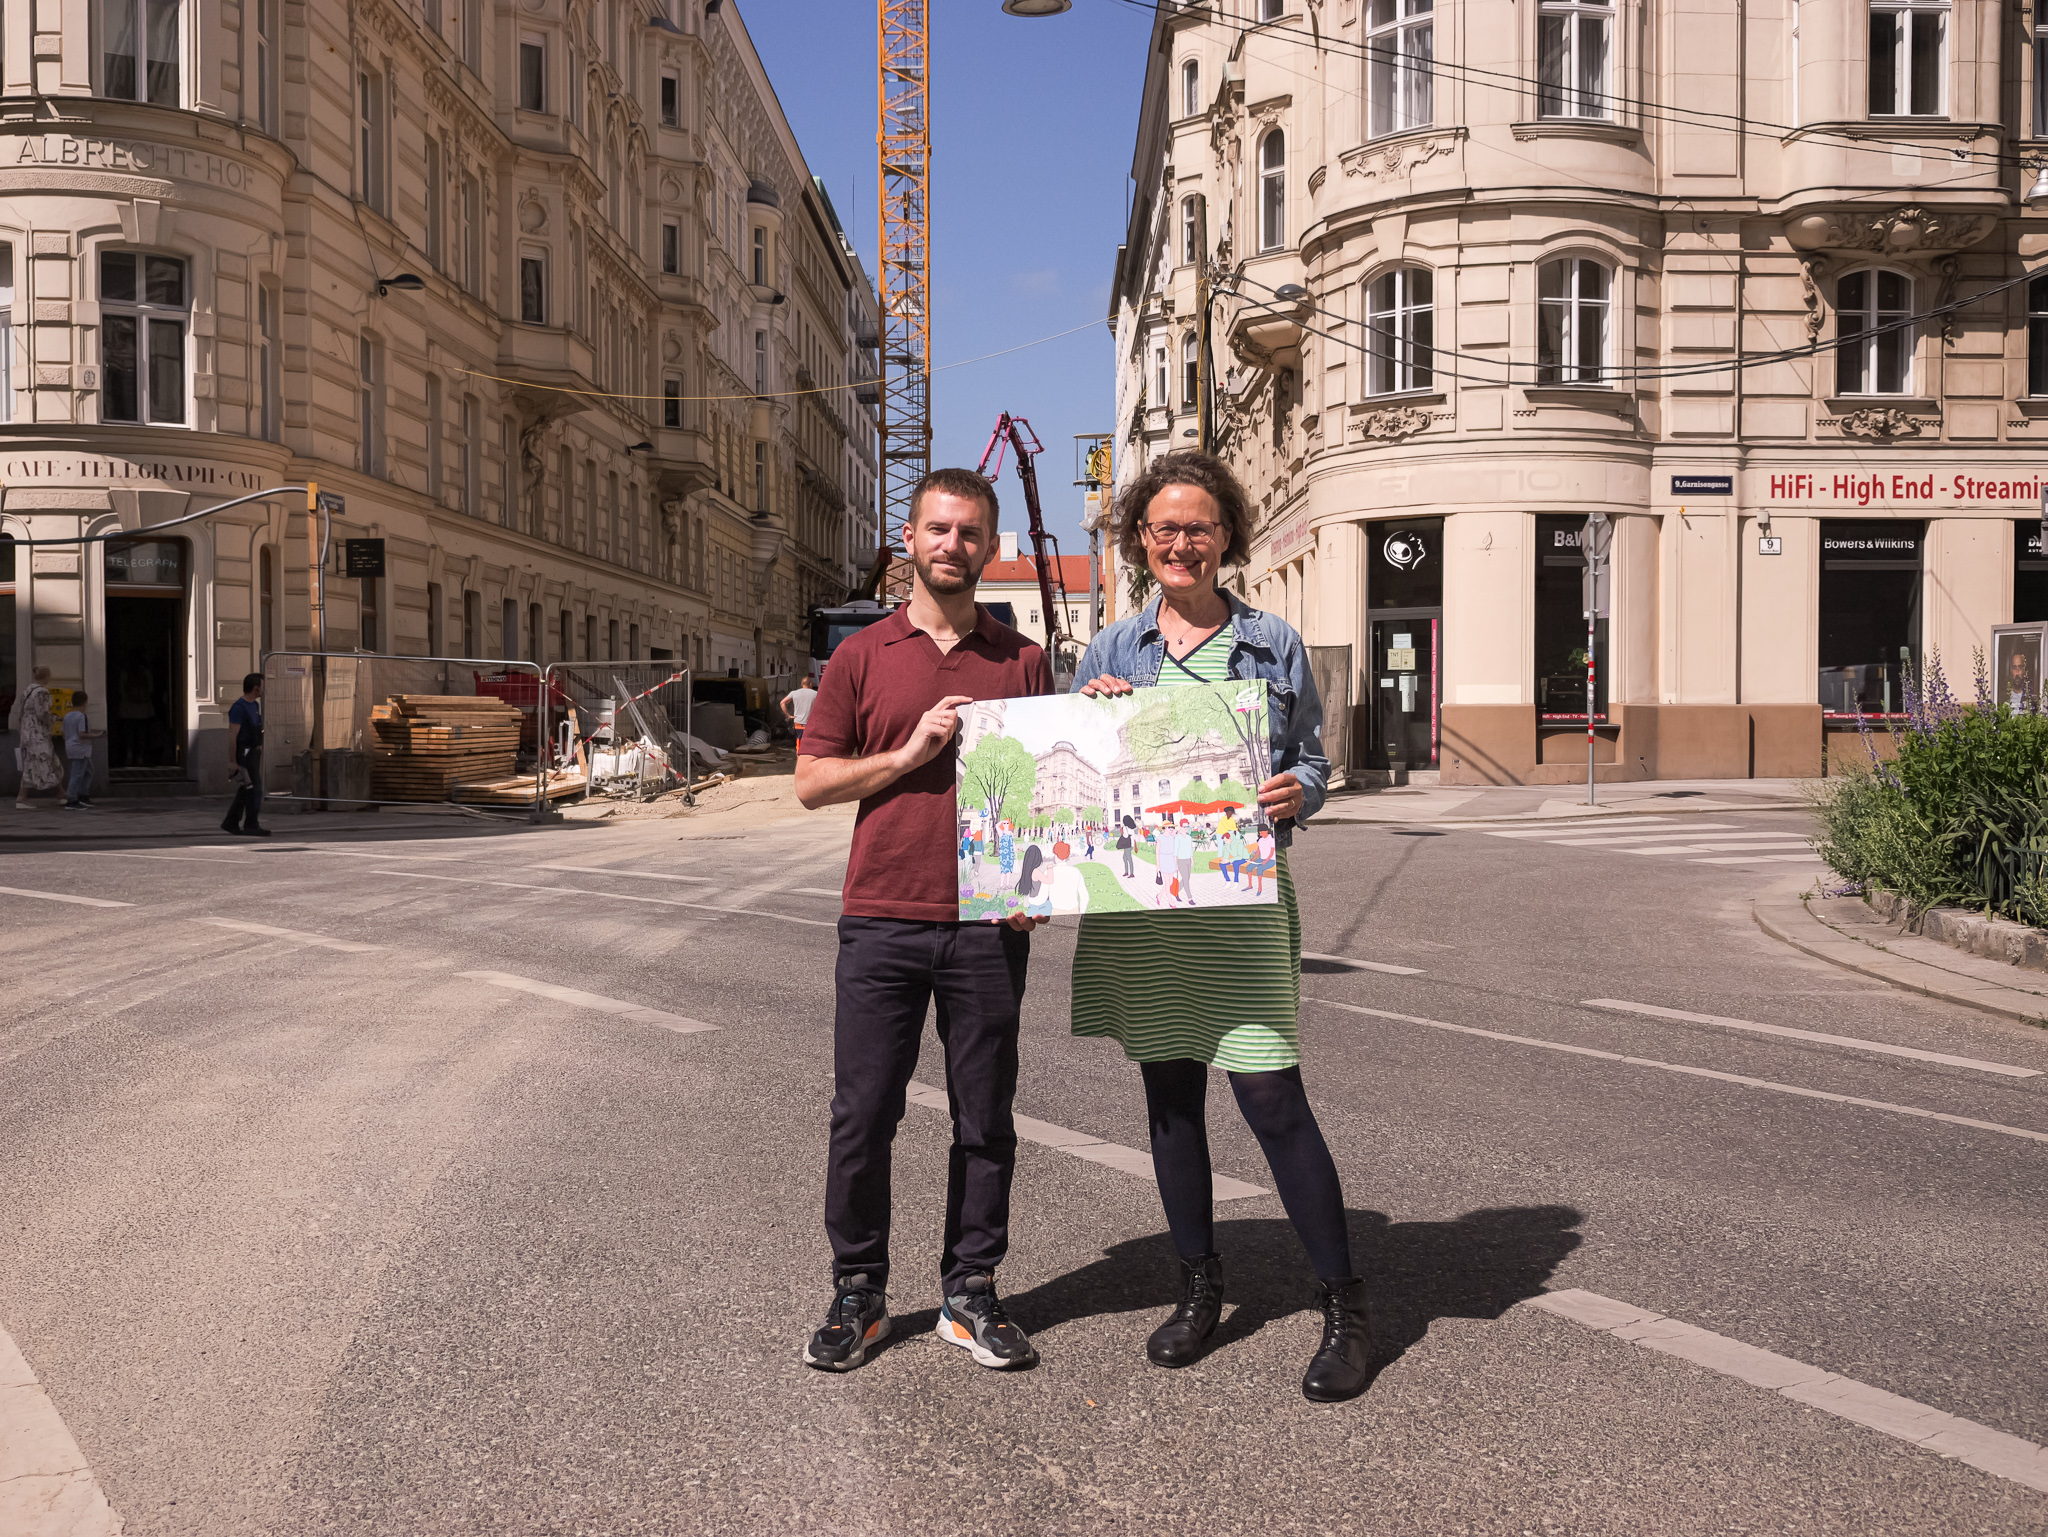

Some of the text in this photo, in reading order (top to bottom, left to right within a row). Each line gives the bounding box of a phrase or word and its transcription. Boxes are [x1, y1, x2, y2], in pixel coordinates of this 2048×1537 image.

[76, 461, 215, 484] TELEGRAPH
[1771, 475, 1813, 499] HiFi
[1834, 474, 1885, 506] High
[1892, 474, 1933, 499] End
[1767, 539, 1774, 549] 9
[1824, 538, 1866, 549] Bowers
[1874, 538, 1915, 549] Wilkins
[110, 557, 178, 568] TELEGRAPH
